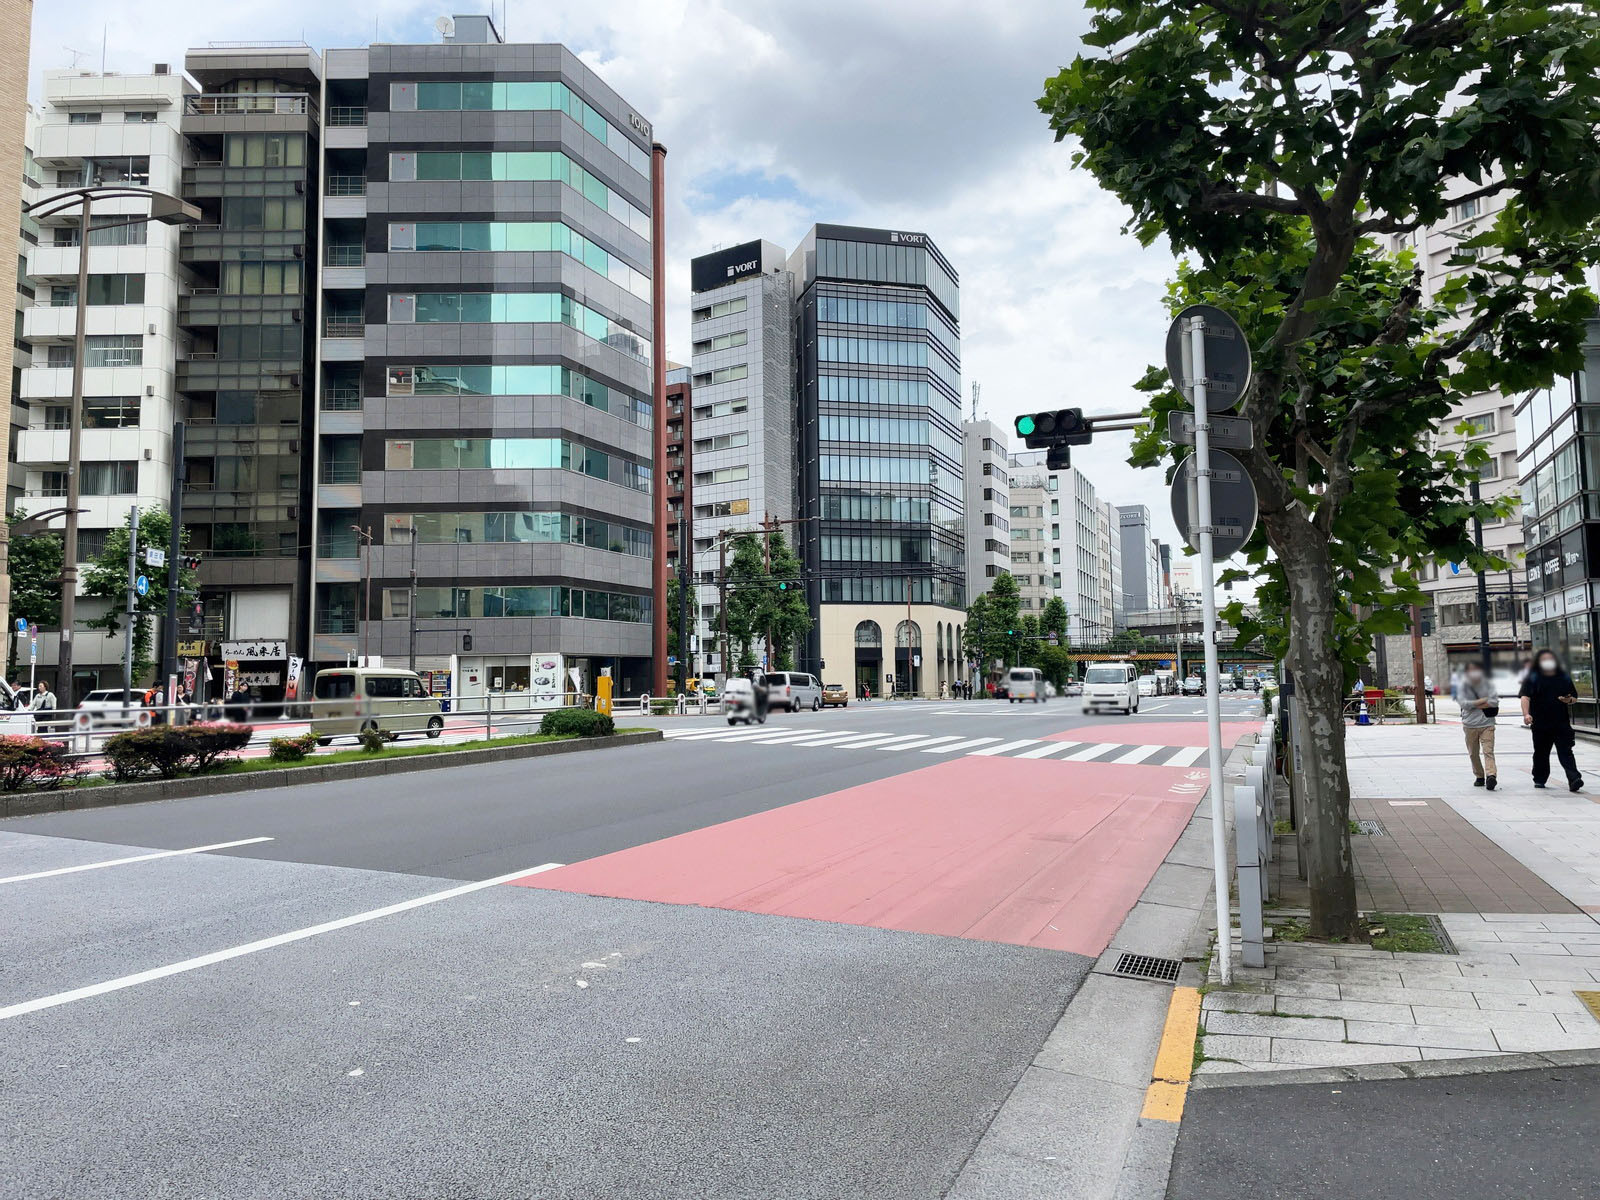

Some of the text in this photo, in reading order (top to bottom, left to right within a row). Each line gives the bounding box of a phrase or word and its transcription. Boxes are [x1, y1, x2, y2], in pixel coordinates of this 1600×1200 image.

[900, 233, 925, 243] VORT
[735, 260, 758, 273] VORT
[1544, 556, 1560, 576] COFFEE
[246, 646, 281, 657] 風来居
